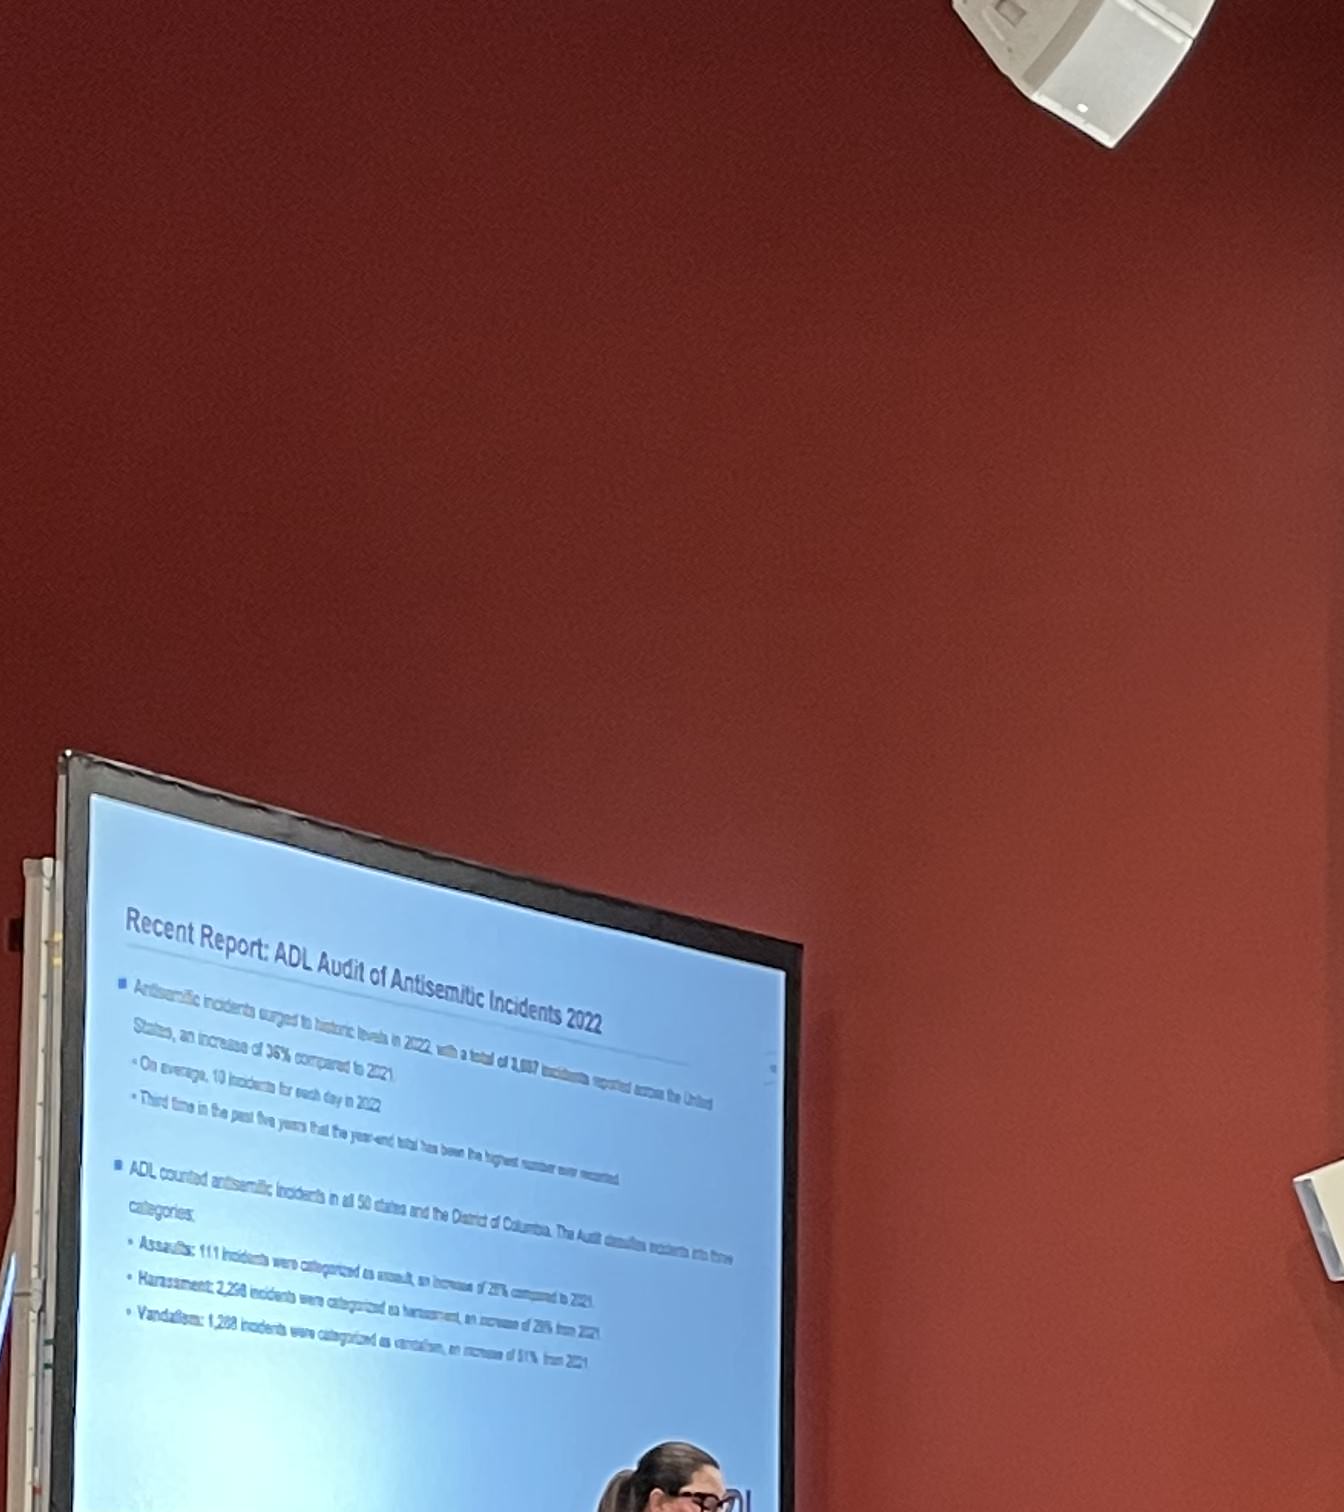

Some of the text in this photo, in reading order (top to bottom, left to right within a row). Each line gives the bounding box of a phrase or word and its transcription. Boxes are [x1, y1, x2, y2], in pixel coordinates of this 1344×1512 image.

[125, 906, 602, 1034] Recent Report: ADL Audit of Antisemitic Incidents 2022
[128, 1159, 157, 1178] ADL
[158, 1165, 208, 1186] counted
